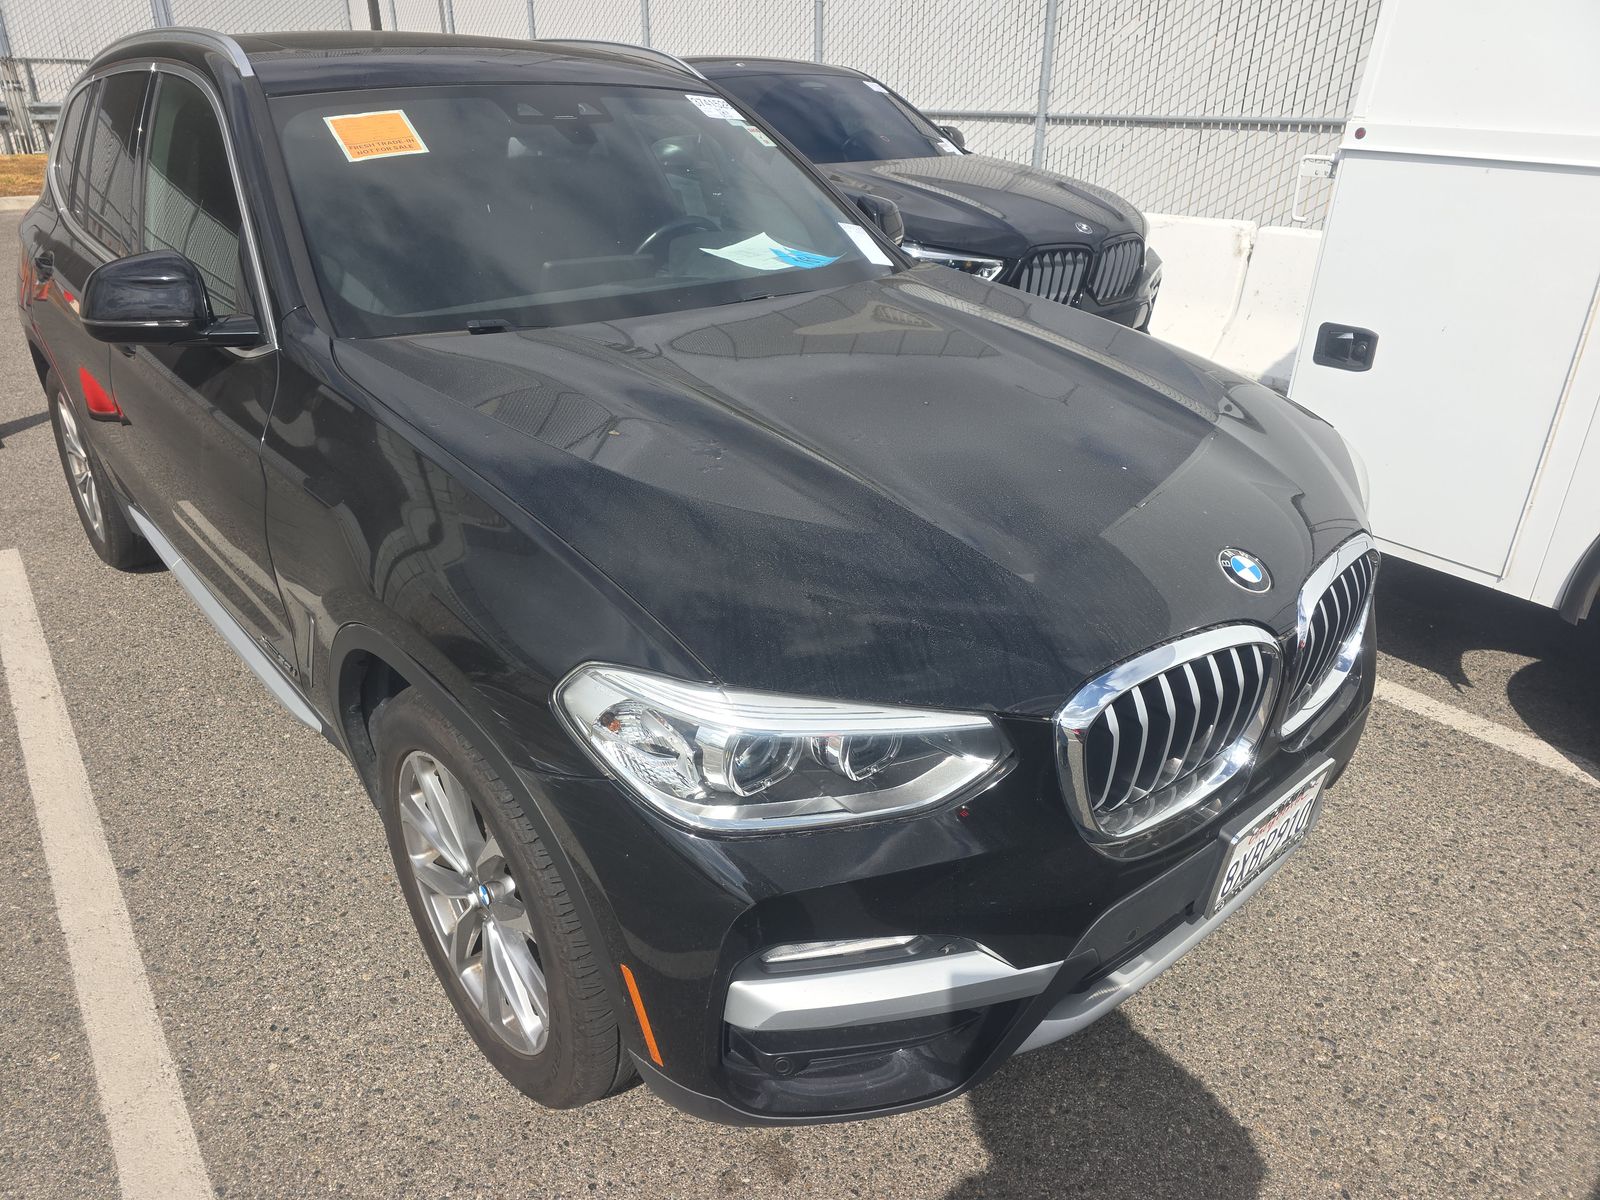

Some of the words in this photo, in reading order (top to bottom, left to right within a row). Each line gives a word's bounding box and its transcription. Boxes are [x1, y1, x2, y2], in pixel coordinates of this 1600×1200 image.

[348, 143, 375, 151] FRESH
[376, 138, 415, 147] TRADE-IN
[357, 148, 375, 156] NOT
[1219, 798, 1314, 898] 8XBP910
